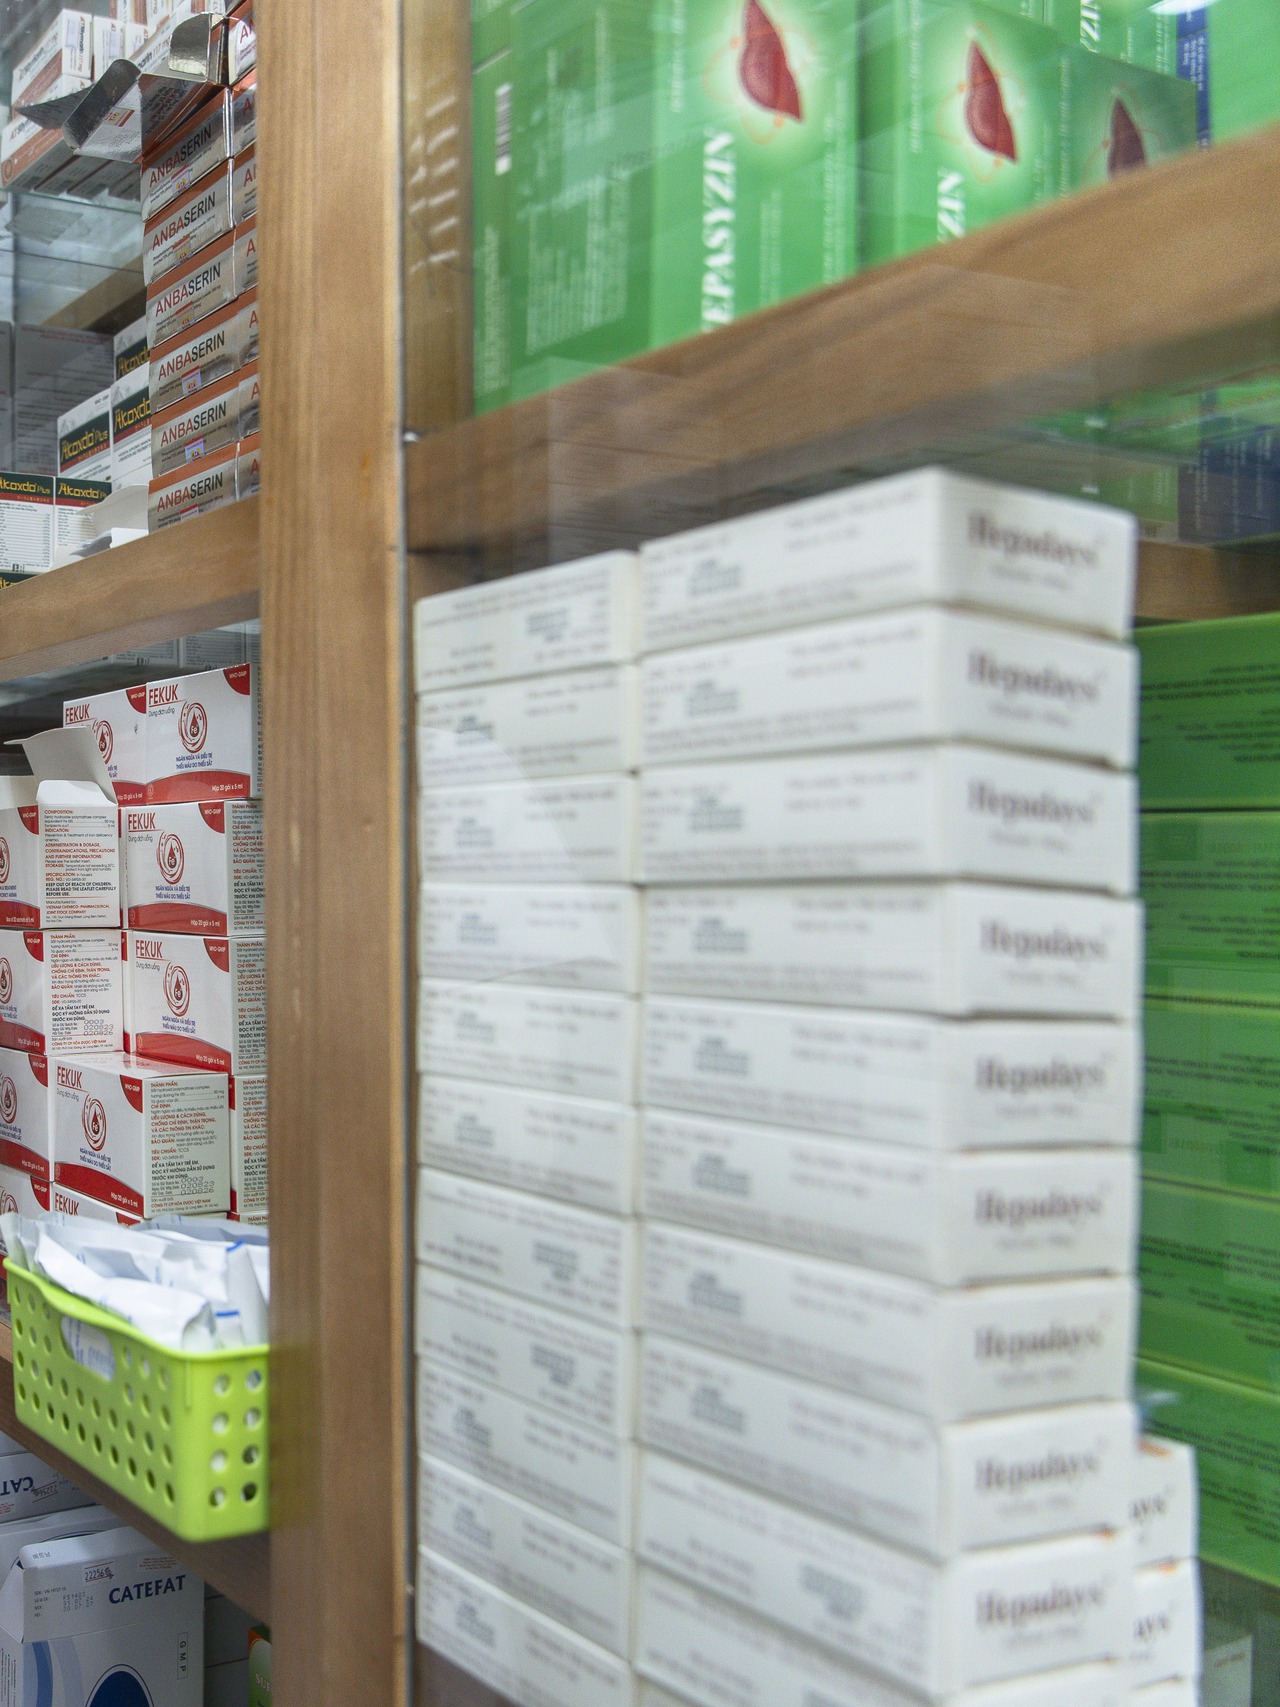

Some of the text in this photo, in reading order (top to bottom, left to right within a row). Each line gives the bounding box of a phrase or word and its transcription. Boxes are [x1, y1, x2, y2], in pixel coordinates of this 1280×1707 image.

[150, 123, 212, 188] ANBASERIN
[152, 191, 216, 251] ANBASERIN
[155, 262, 221, 317] ANBASERIN
[158, 330, 225, 381] ANBASERIN
[160, 400, 227, 447] ANBASERIN
[61, 431, 94, 462] Akoxdo
[37, 485, 51, 494] Plus
[58, 483, 99, 499] Akoxdo
[157, 472, 223, 513] ANBASERIN
[148, 683, 179, 706] FEKUK
[65, 704, 90, 723] FEKUK
[128, 812, 156, 830] FEKUK
[136, 940, 163, 958] FEKUK
[56, 1066, 83, 1089] FEKUK
[54, 1192, 80, 1216] FEKUK
[108, 1574, 187, 1604] CATEFAT
[179, 1640, 187, 1672] GMP
